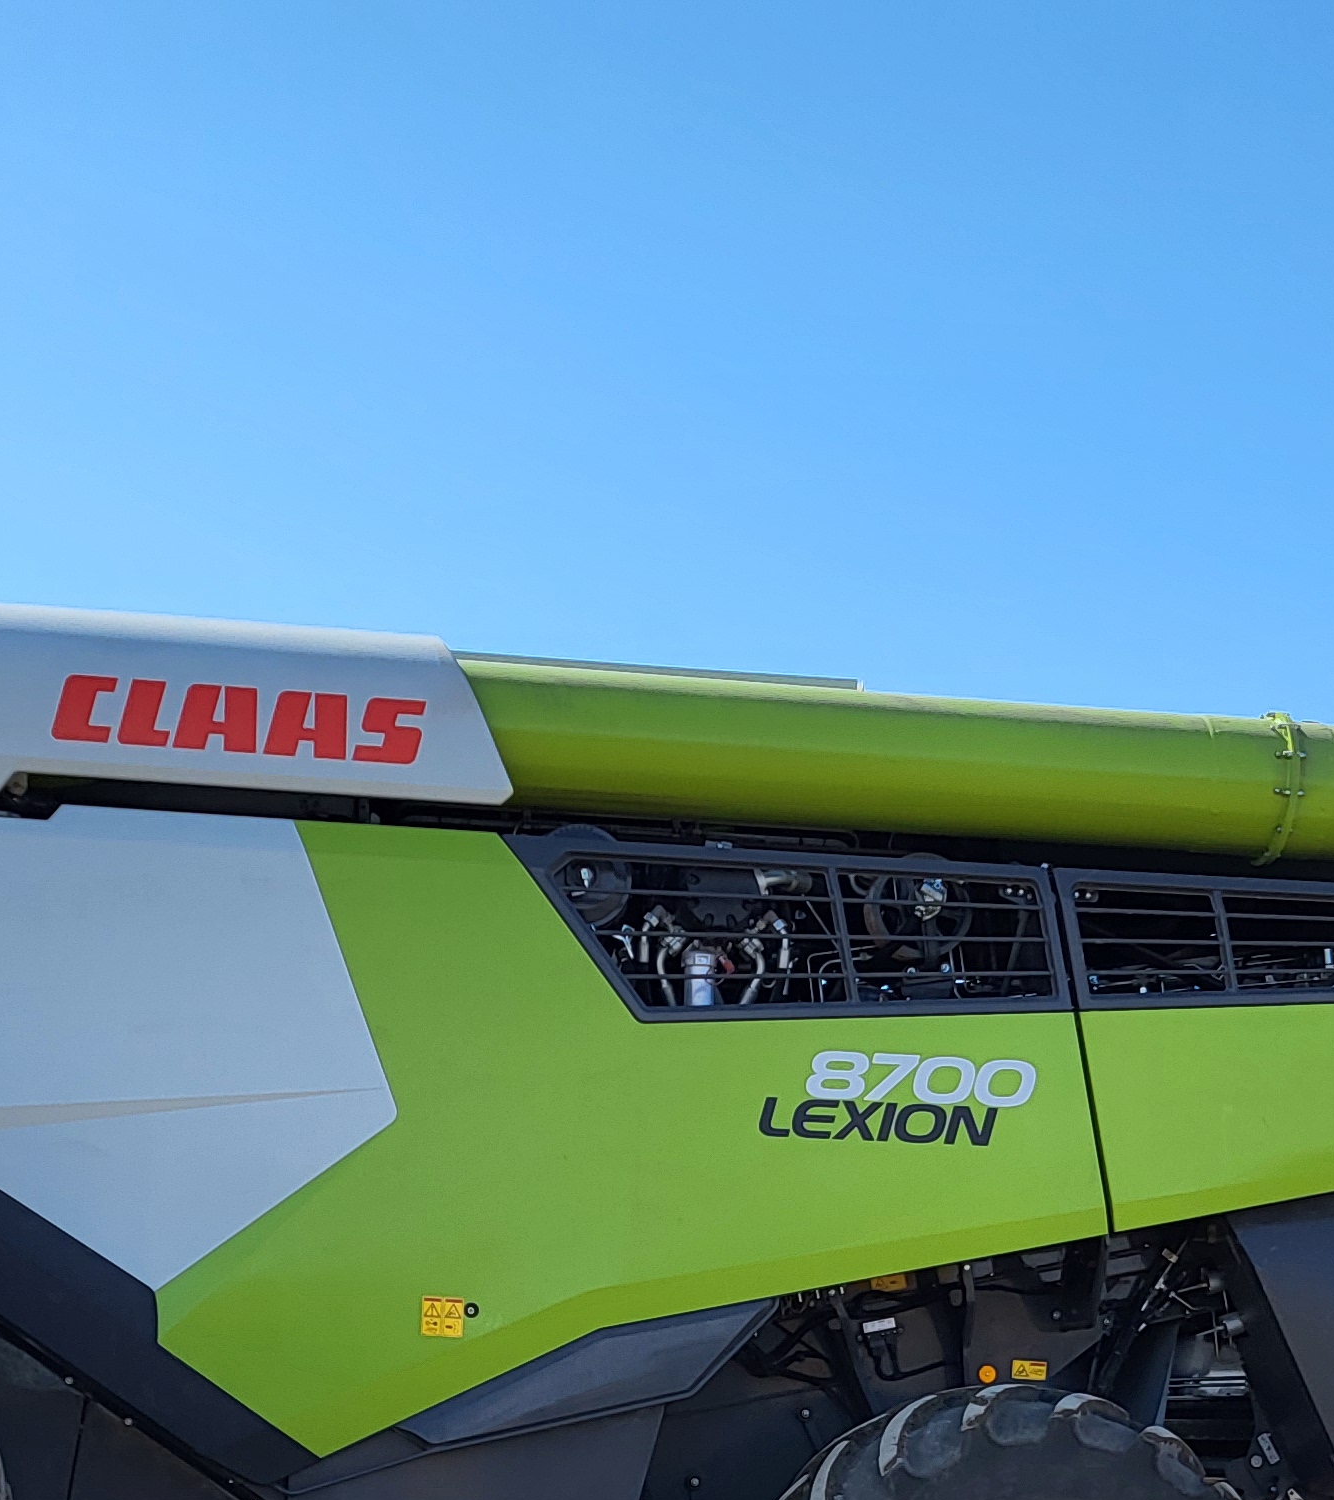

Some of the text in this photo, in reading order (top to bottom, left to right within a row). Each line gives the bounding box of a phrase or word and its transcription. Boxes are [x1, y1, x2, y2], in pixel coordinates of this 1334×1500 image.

[50, 674, 427, 765] CLAAS
[805, 1050, 1037, 1108] 8700
[759, 1096, 998, 1147] LEXION
